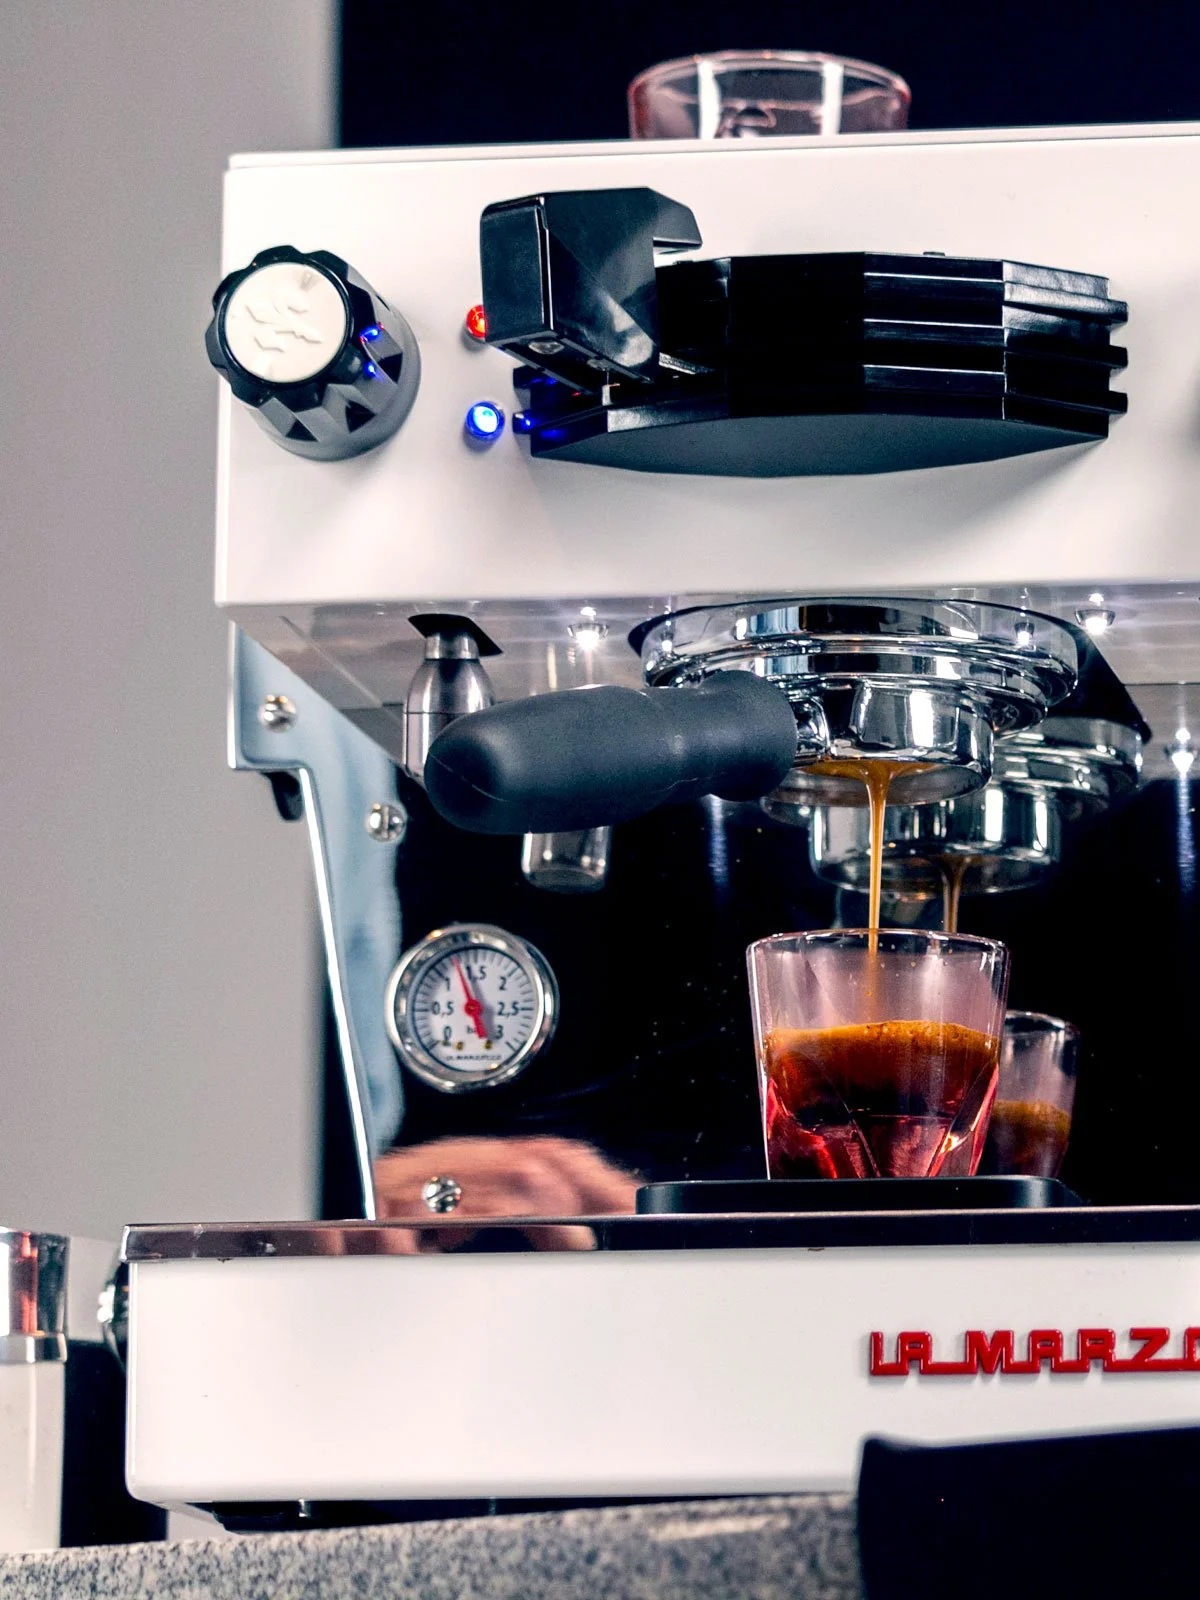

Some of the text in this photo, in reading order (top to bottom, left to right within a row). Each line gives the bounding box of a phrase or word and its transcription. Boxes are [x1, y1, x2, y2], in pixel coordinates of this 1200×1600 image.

[445, 977, 451, 991] 1
[499, 976, 508, 991] 2
[431, 1001, 454, 1018] 0,5
[498, 1001, 519, 1018] 2,5
[495, 1025, 504, 1040] 3
[870, 1331, 932, 1376] LA
